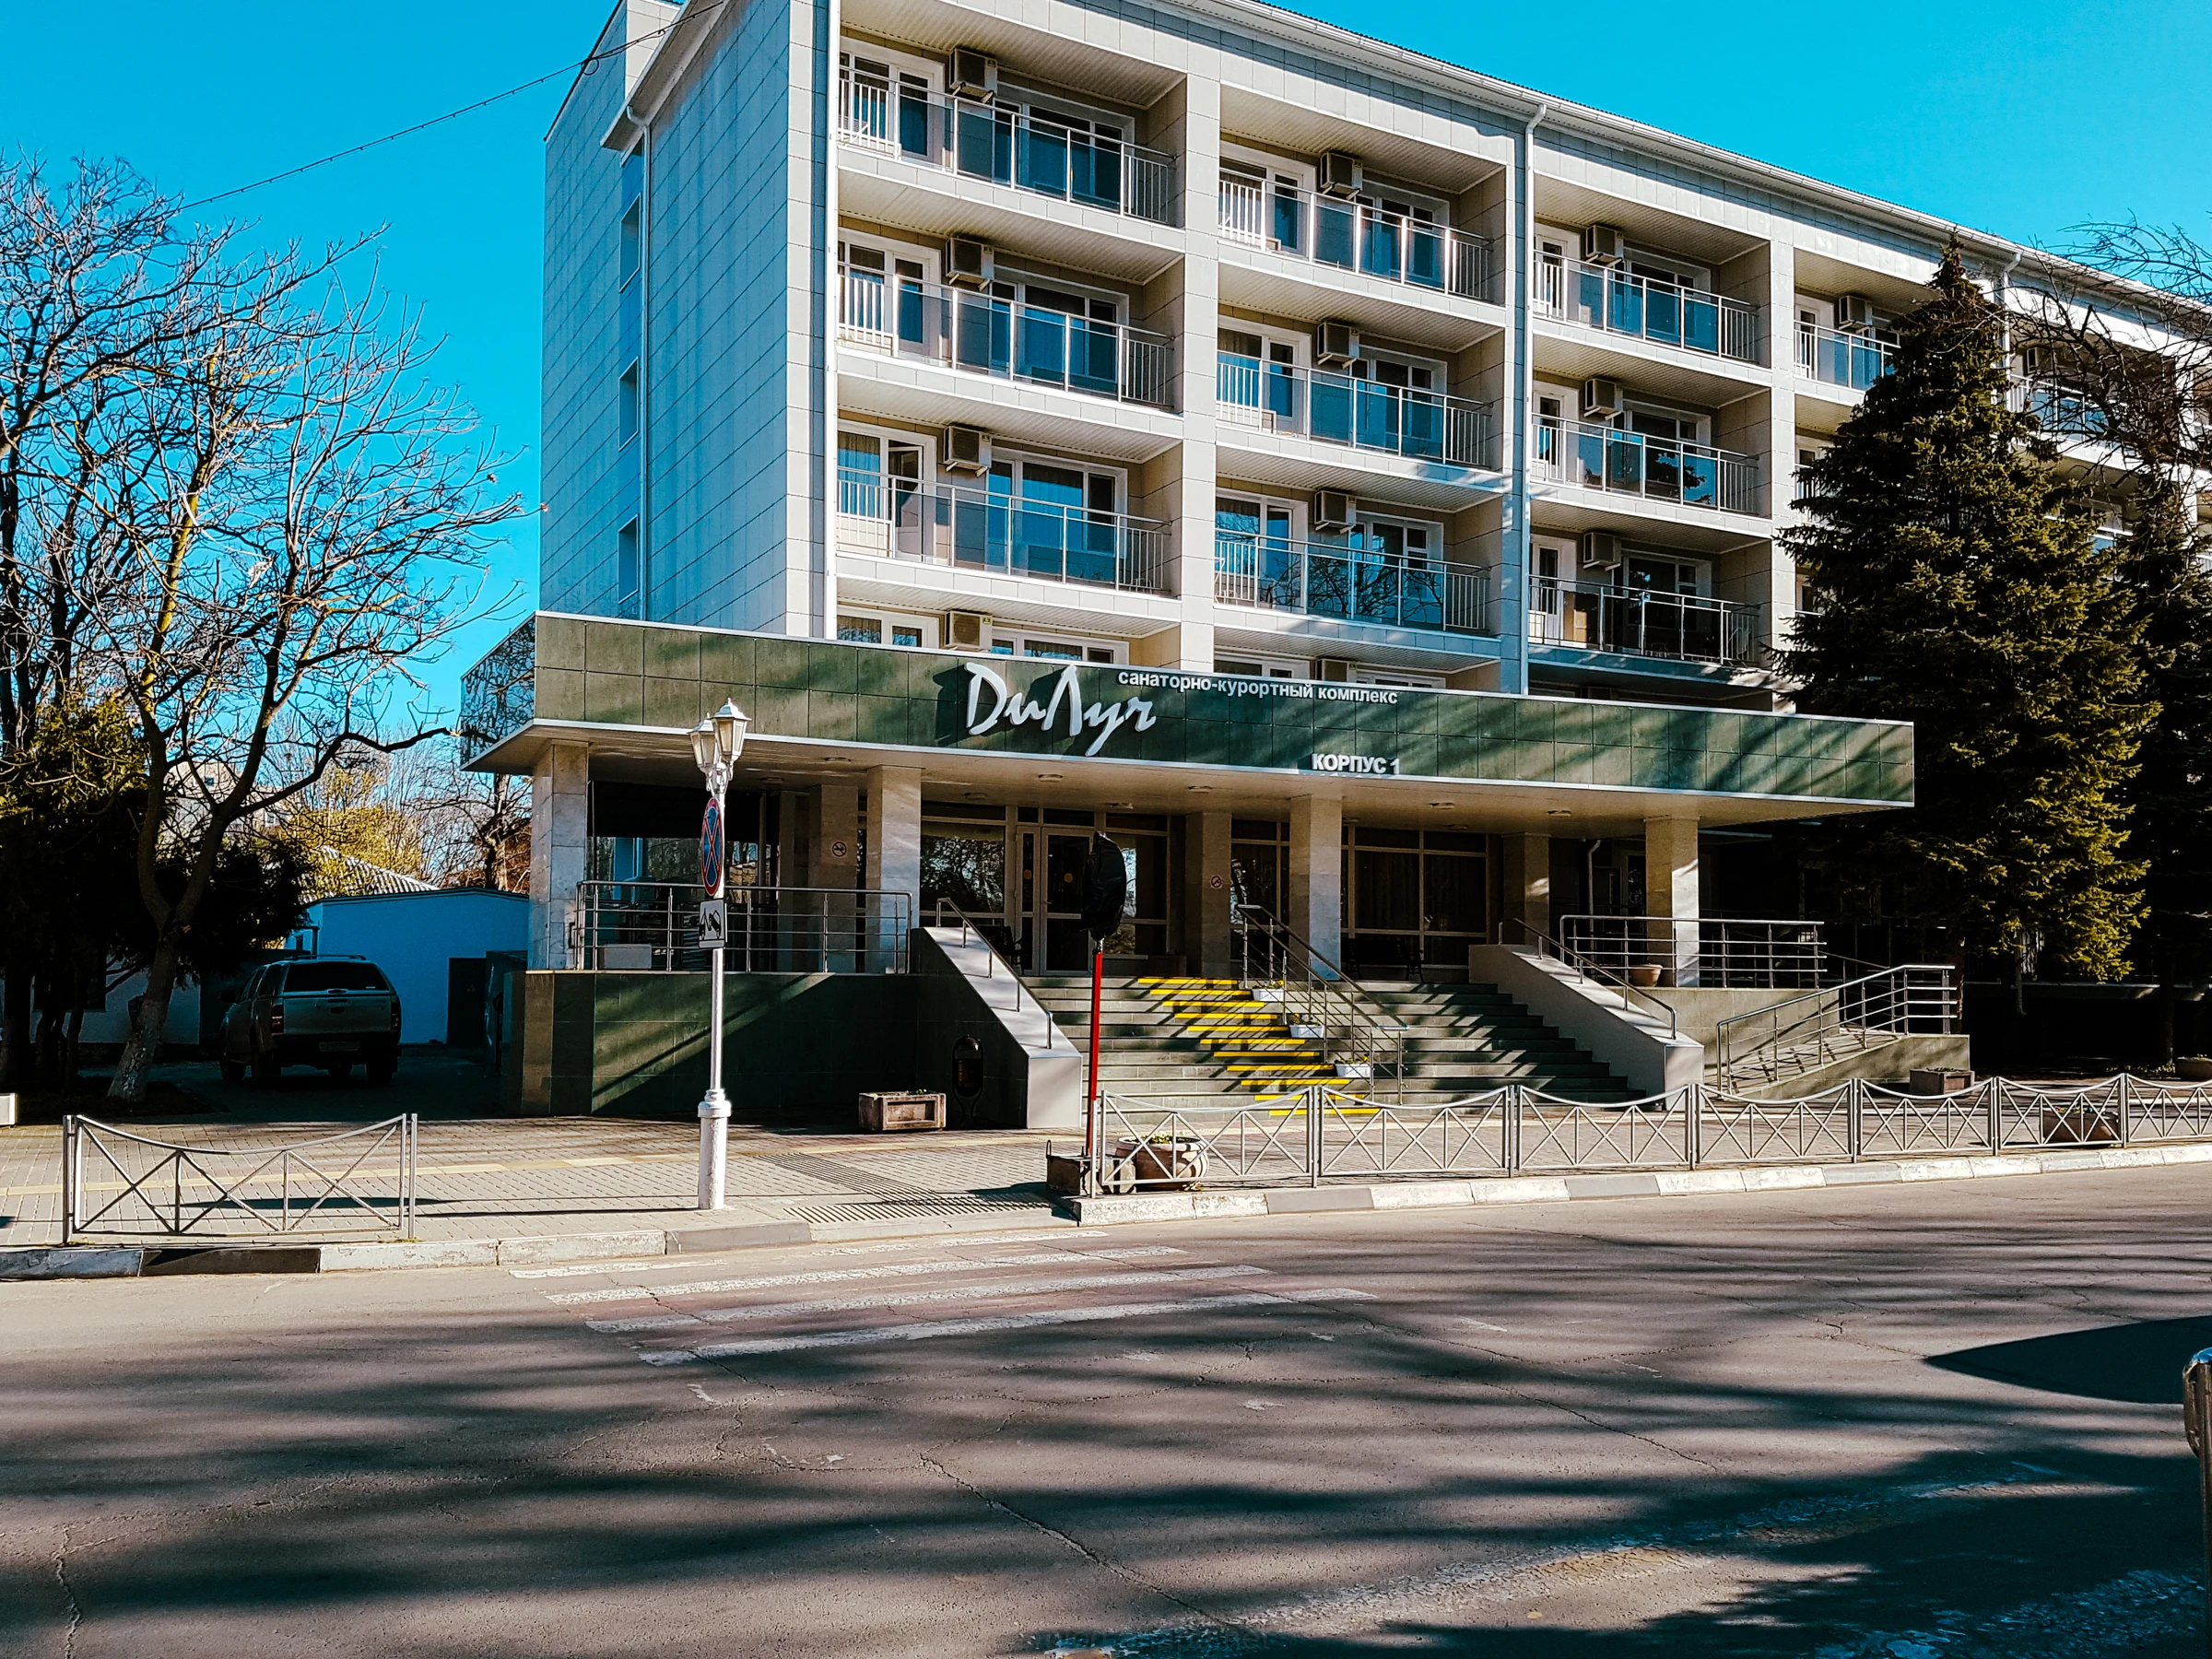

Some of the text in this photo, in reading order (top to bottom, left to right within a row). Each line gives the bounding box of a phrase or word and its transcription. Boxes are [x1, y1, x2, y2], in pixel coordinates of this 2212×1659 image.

[1118, 671, 1398, 705] санаторно-курортный комплекс
[1312, 753, 1400, 775] КОРПУС 1
